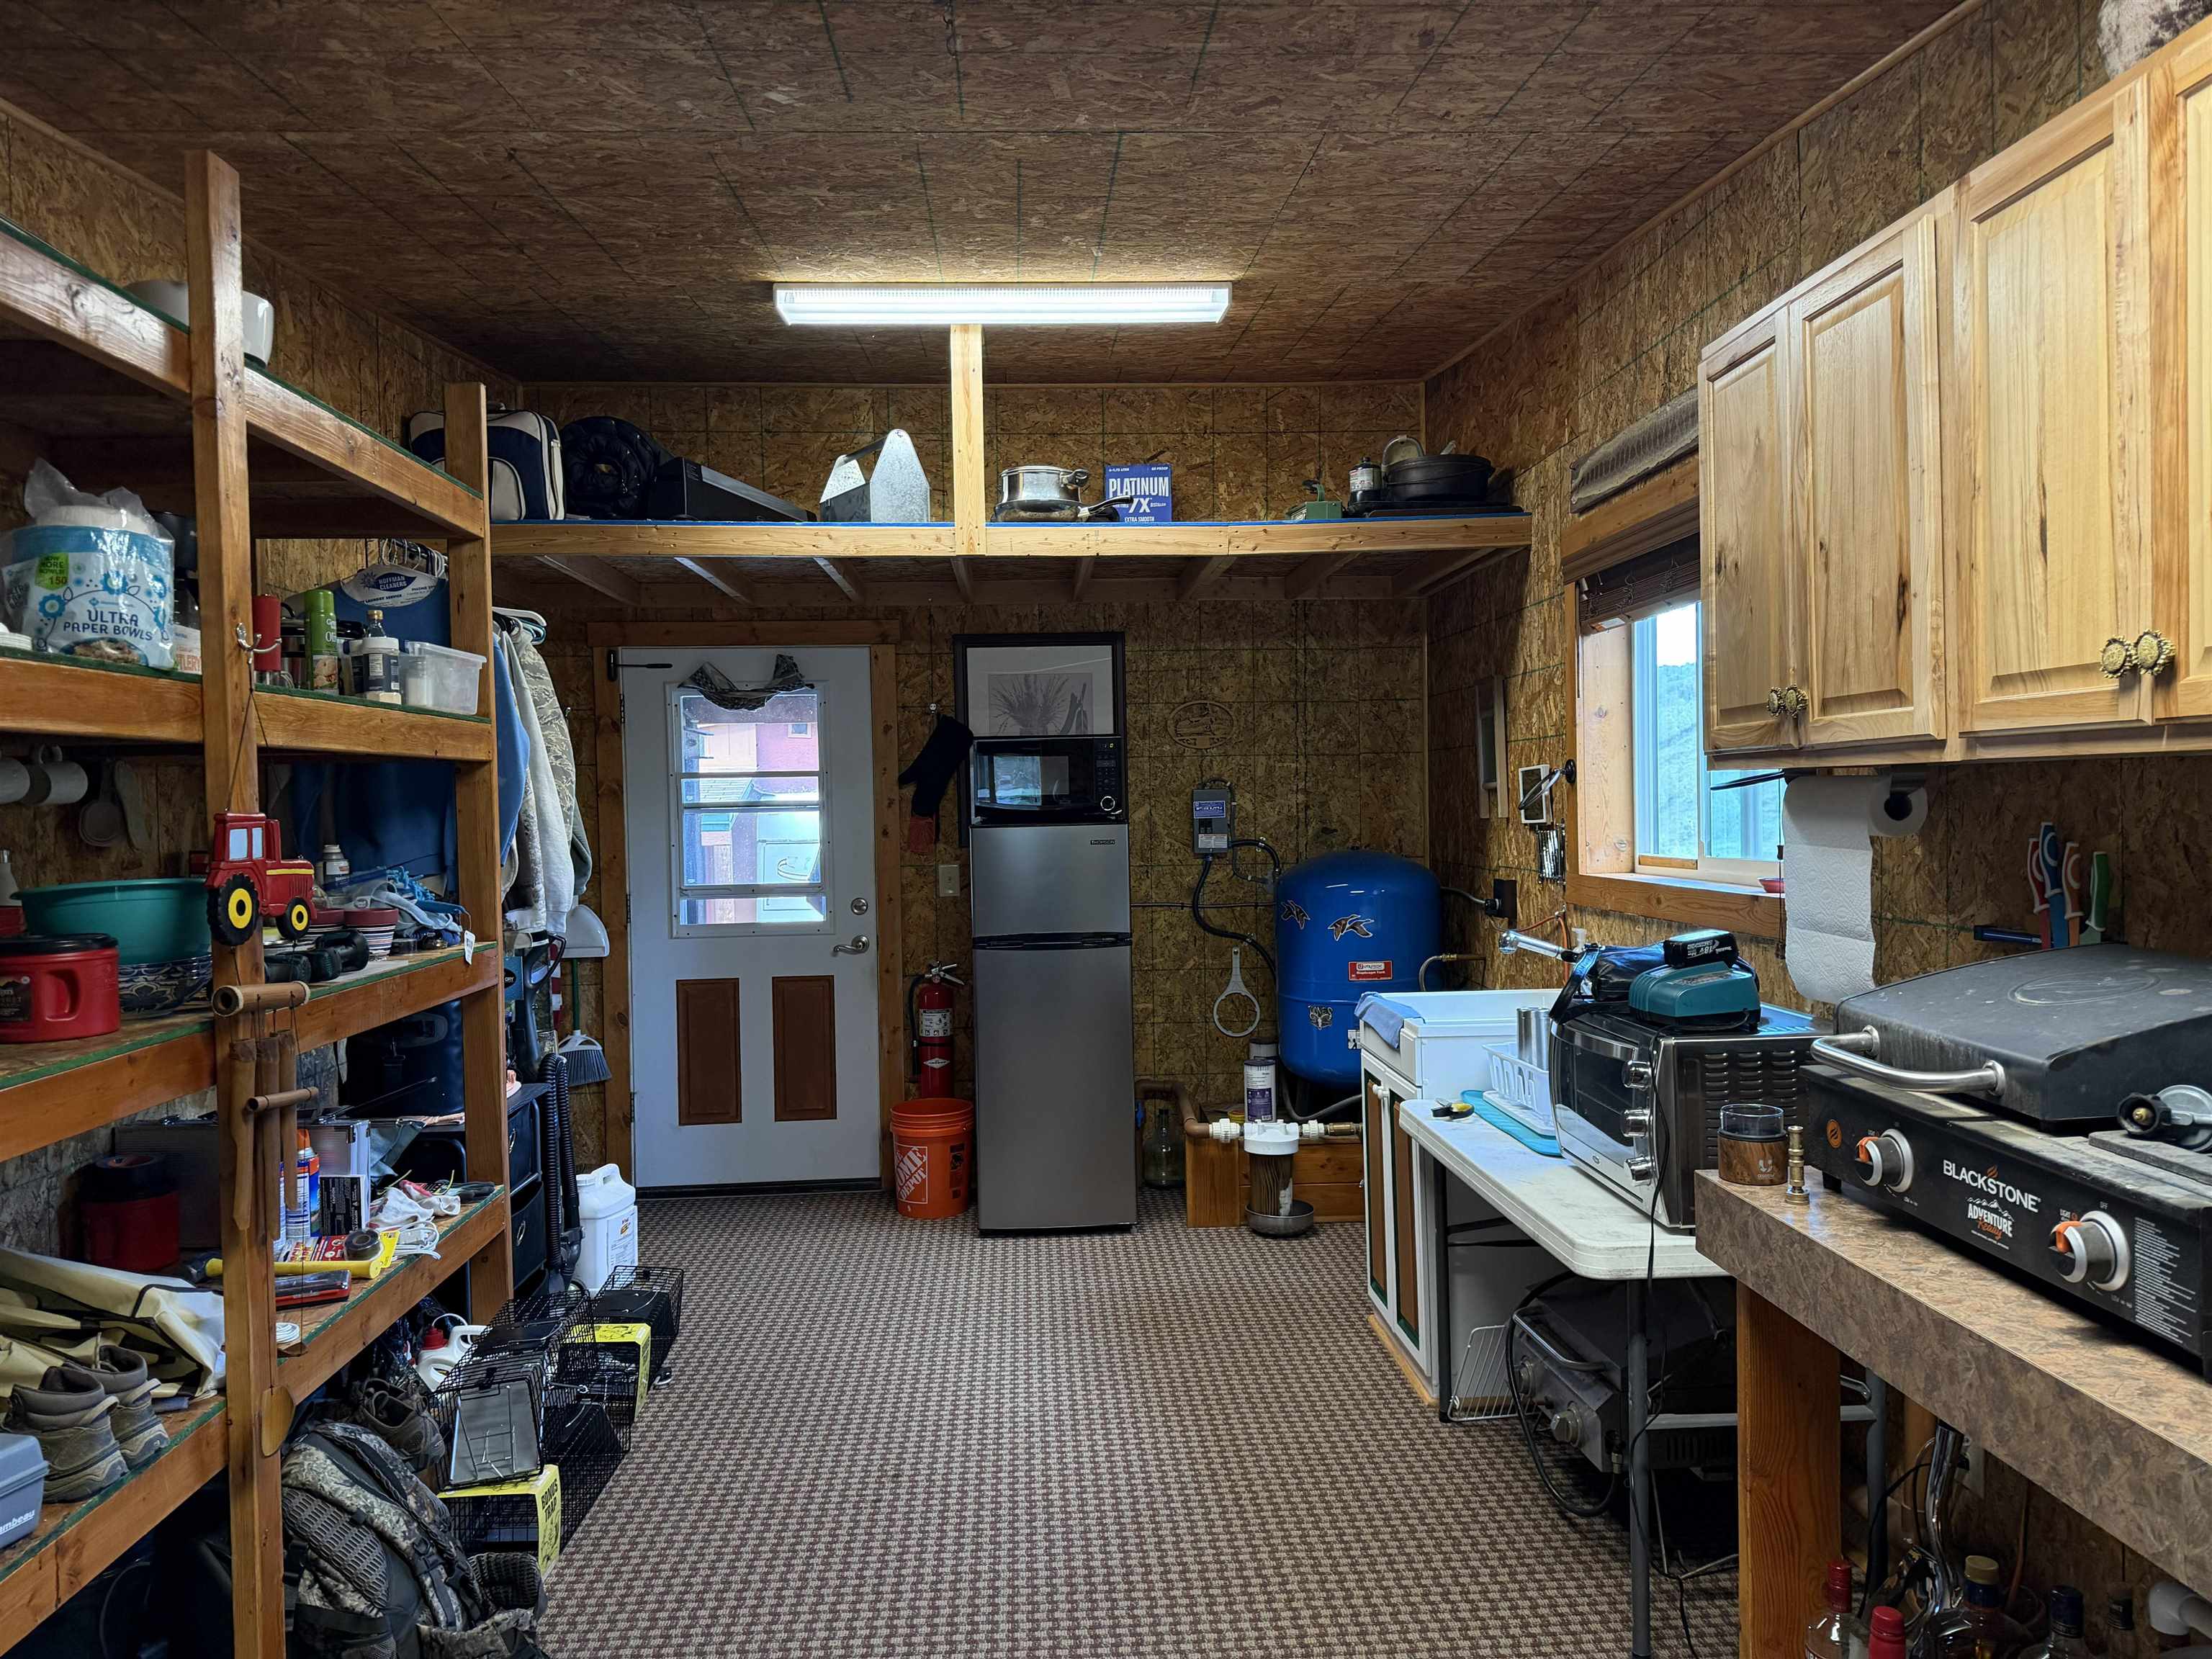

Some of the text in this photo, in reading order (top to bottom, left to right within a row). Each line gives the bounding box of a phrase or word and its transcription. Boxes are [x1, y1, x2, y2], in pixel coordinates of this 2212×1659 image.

[1108, 477, 1169, 498] PLATINUM
[1128, 498, 1151, 513] 7X
[379, 580, 407, 590] CLEANERS
[87, 609, 139, 626] ULTRA
[63, 621, 153, 641] PAPER BOWLS
[1943, 1159, 2041, 1213] BLACKSTONE
[1967, 1203, 2013, 1238] ADVENTURE
[541, 1478, 557, 1511] BONUS
[545, 1496, 557, 1523] TRAP
